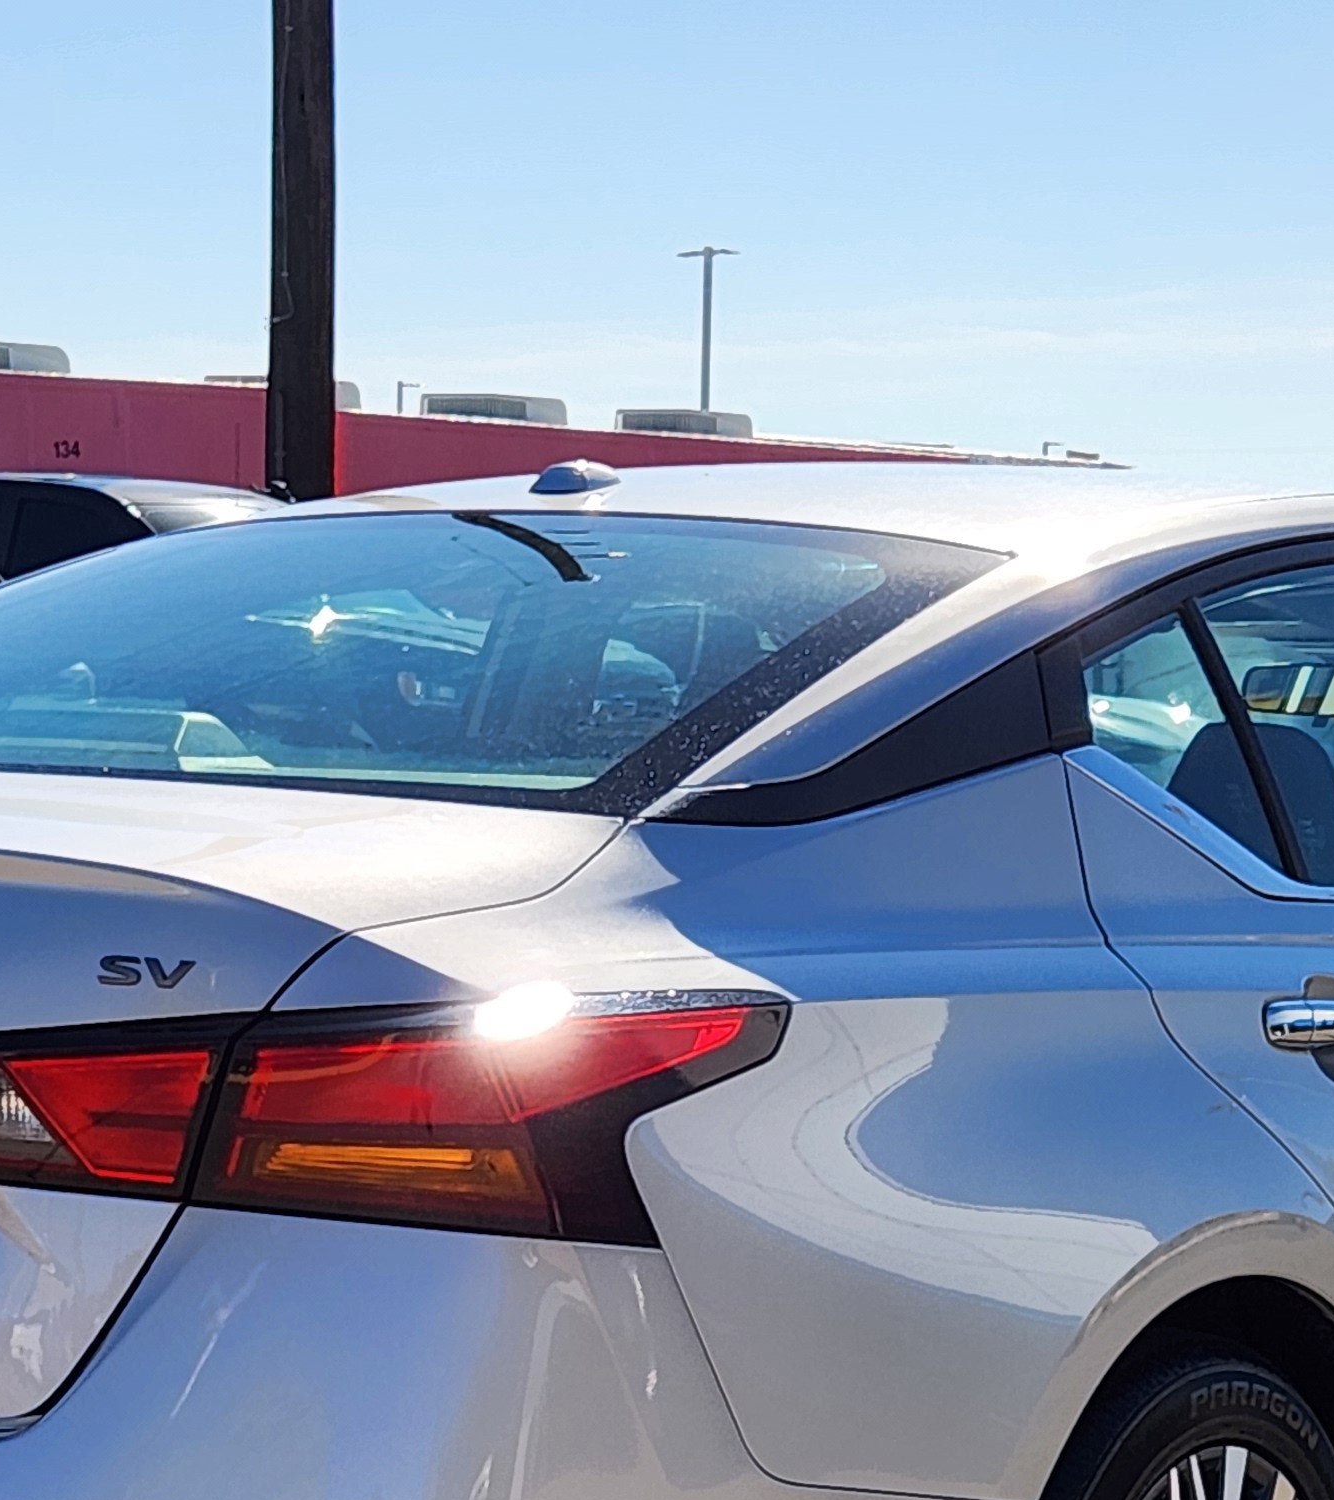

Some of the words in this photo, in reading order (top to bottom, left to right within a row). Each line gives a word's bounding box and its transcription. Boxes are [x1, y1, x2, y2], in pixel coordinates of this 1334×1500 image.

[53, 440, 81, 458] 134
[97, 955, 197, 989] SV
[1189, 1380, 1319, 1450] PARAGON
